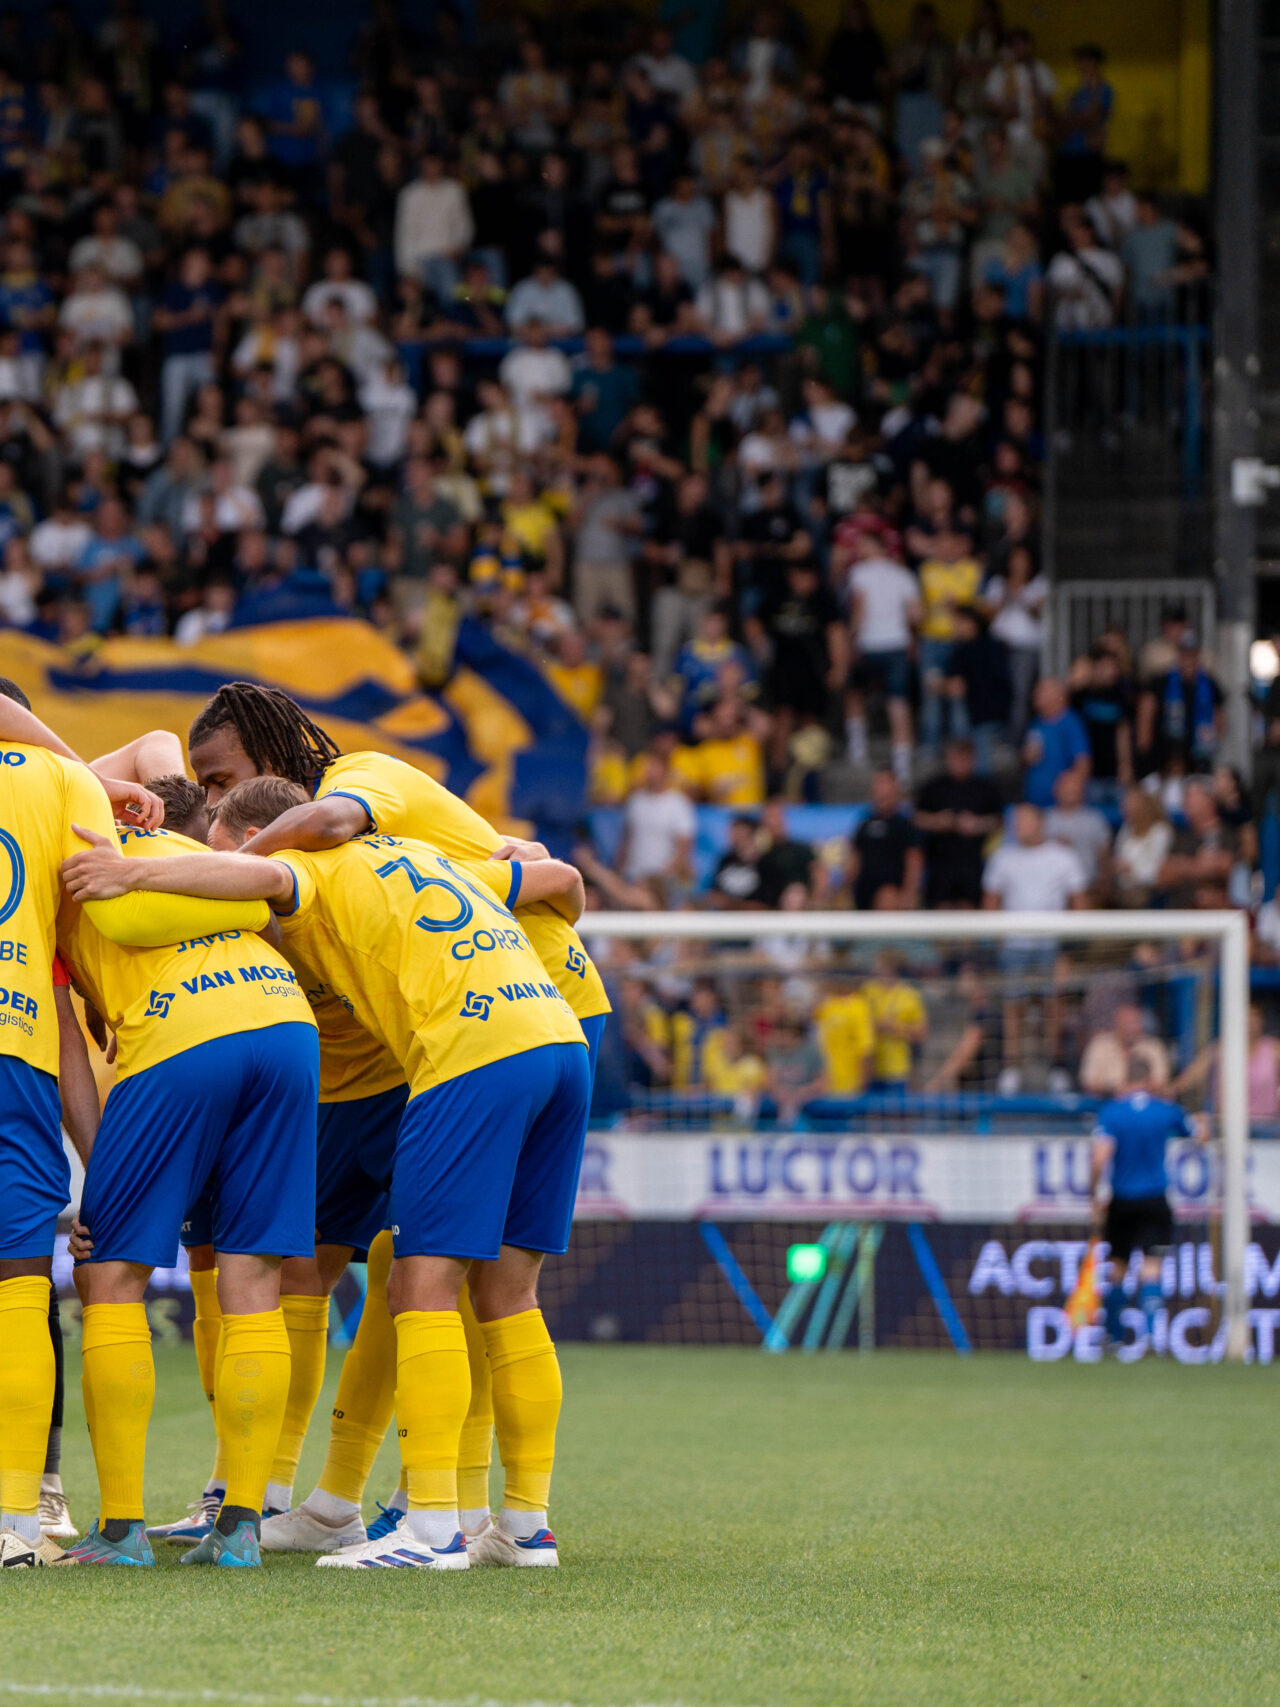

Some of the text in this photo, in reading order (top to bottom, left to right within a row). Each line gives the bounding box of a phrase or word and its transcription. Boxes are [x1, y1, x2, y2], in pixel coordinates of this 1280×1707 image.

[180, 970, 236, 995] VAN
[497, 982, 540, 1002] VAN
[709, 1145, 924, 1196] LUCTOR
